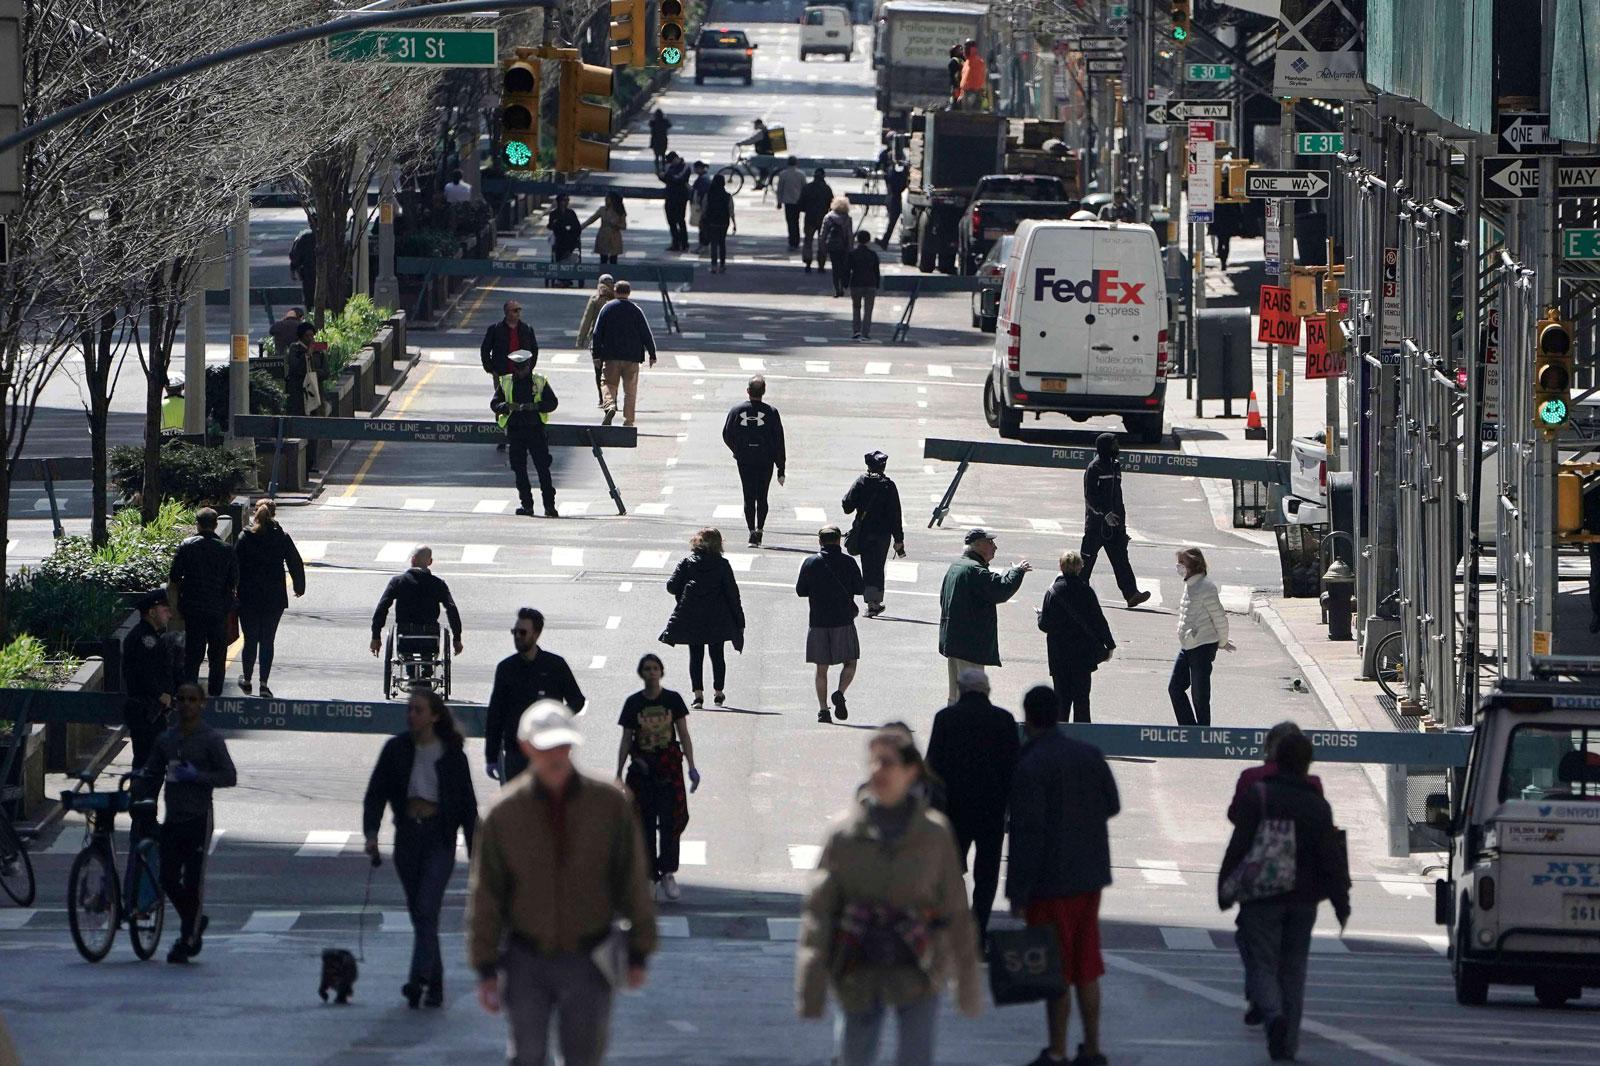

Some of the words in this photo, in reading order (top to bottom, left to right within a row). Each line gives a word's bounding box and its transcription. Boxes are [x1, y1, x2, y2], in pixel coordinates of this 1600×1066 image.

[377, 37, 388, 57] E
[398, 37, 416, 58] 31
[425, 37, 445, 58] St
[1190, 67, 1196, 78] E
[1201, 67, 1216, 78] 30
[1176, 106, 1194, 116] ONE
[1203, 106, 1223, 115] WAY
[1511, 127, 1533, 143] ONE
[1304, 136, 1312, 151] E
[1320, 136, 1333, 152] 31
[1253, 178, 1278, 189] ONE
[1292, 178, 1318, 190] WAY
[1508, 170, 1539, 186] ONE
[1560, 169, 1597, 185] WAY
[1569, 233, 1581, 255] E
[1034, 268, 1146, 305] FedEx
[1386, 283, 1393, 296] 3
[1098, 304, 1140, 317] Express
[1264, 292, 1292, 312] RAIS
[1262, 319, 1297, 340] PLOW
[364, 422, 395, 432] POLICE
[400, 423, 419, 432] LINE
[437, 424, 449, 433] DO
[455, 424, 473, 433] NOT
[1052, 450, 1084, 460] POLICE
[1129, 454, 1141, 463] DO
[1145, 455, 1162, 465] NOT
[1167, 456, 1198, 467] CROSS
[214, 701, 244, 713] LINE
[269, 702, 286, 715] DO
[293, 703, 320, 716] NOT
[326, 704, 372, 718] CROSS
[238, 716, 286, 727] NYPD
[1141, 728, 1188, 743] POLICE
[1201, 730, 1231, 744] LINE
[1312, 732, 1358, 747] CROSS
[1004, 947, 1047, 975] sg
